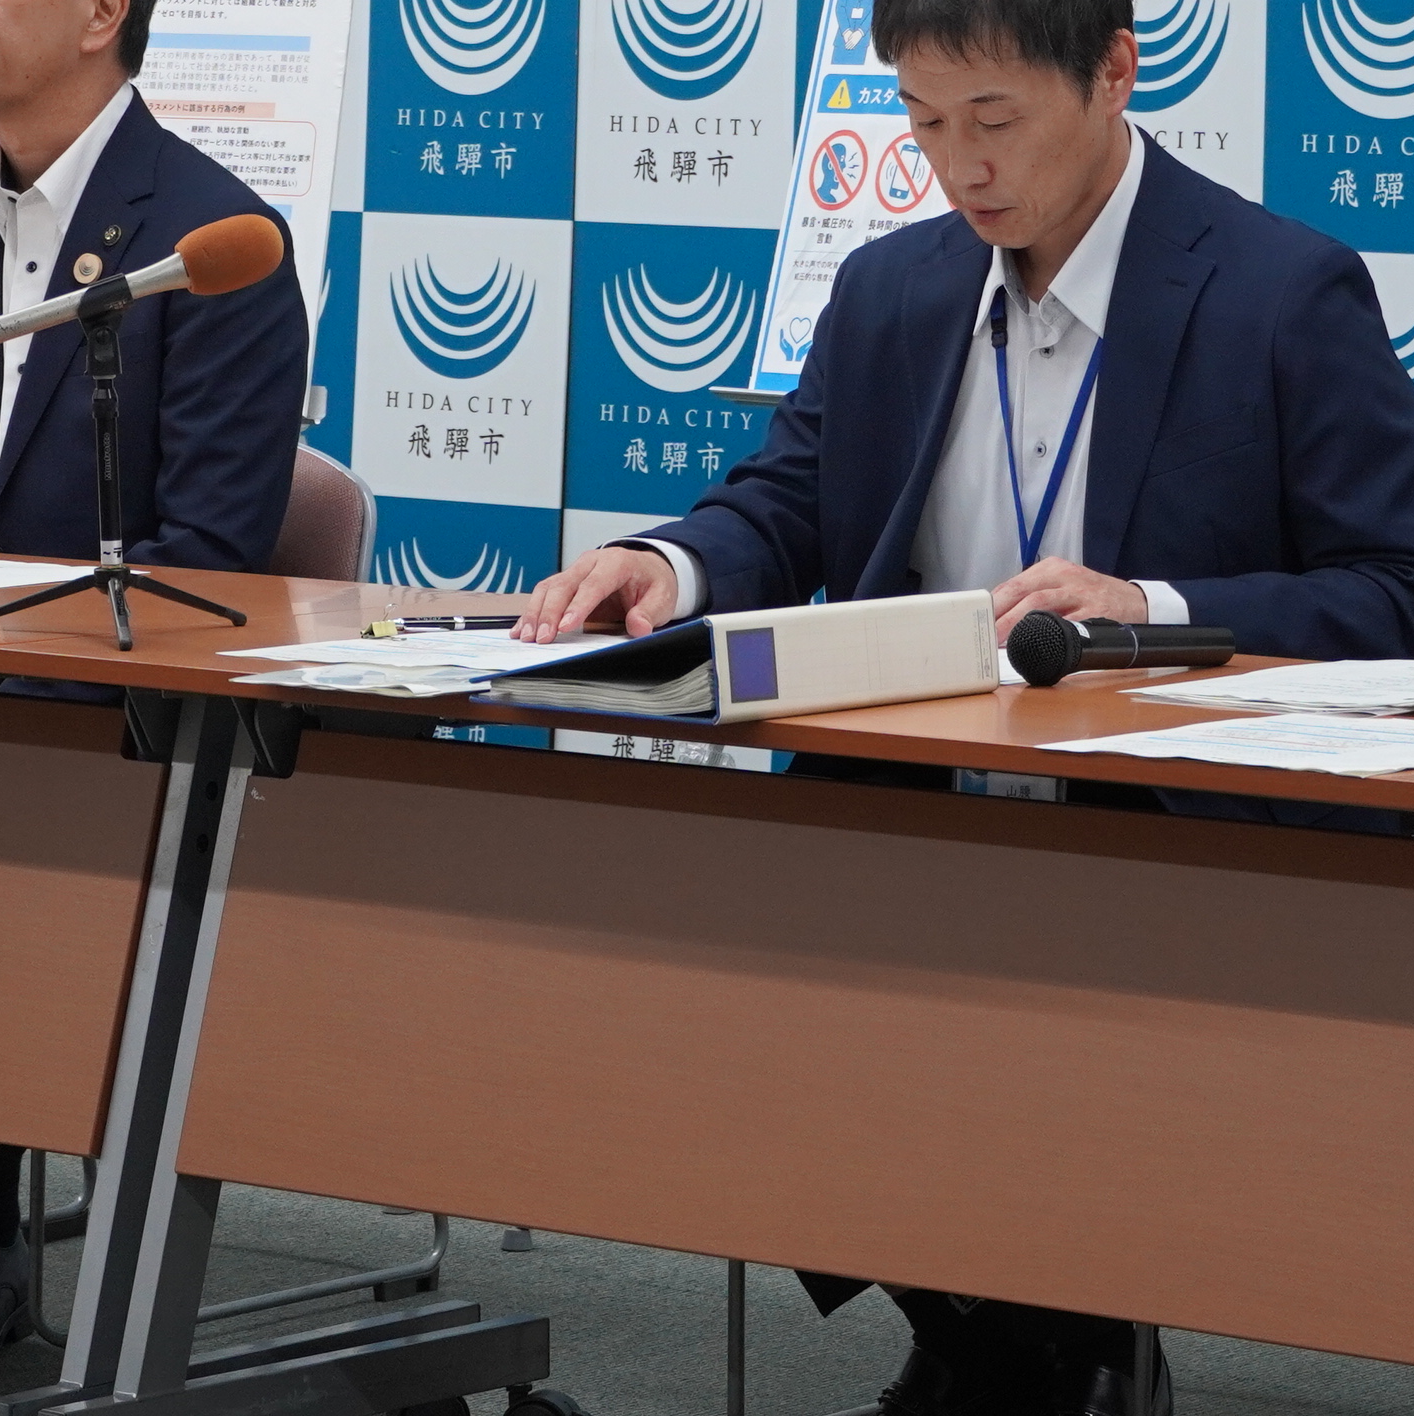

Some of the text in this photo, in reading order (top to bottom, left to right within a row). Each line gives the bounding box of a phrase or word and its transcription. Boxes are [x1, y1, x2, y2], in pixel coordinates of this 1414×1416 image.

[398, 109, 543, 129] HIDA CITY
[610, 115, 761, 136] HIDA CITY
[1302, 134, 1382, 154] HIDA
[816, 232, 833, 245] 言動
[386, 391, 532, 416] HIDA CITY
[600, 404, 752, 430] HIDA CITY
